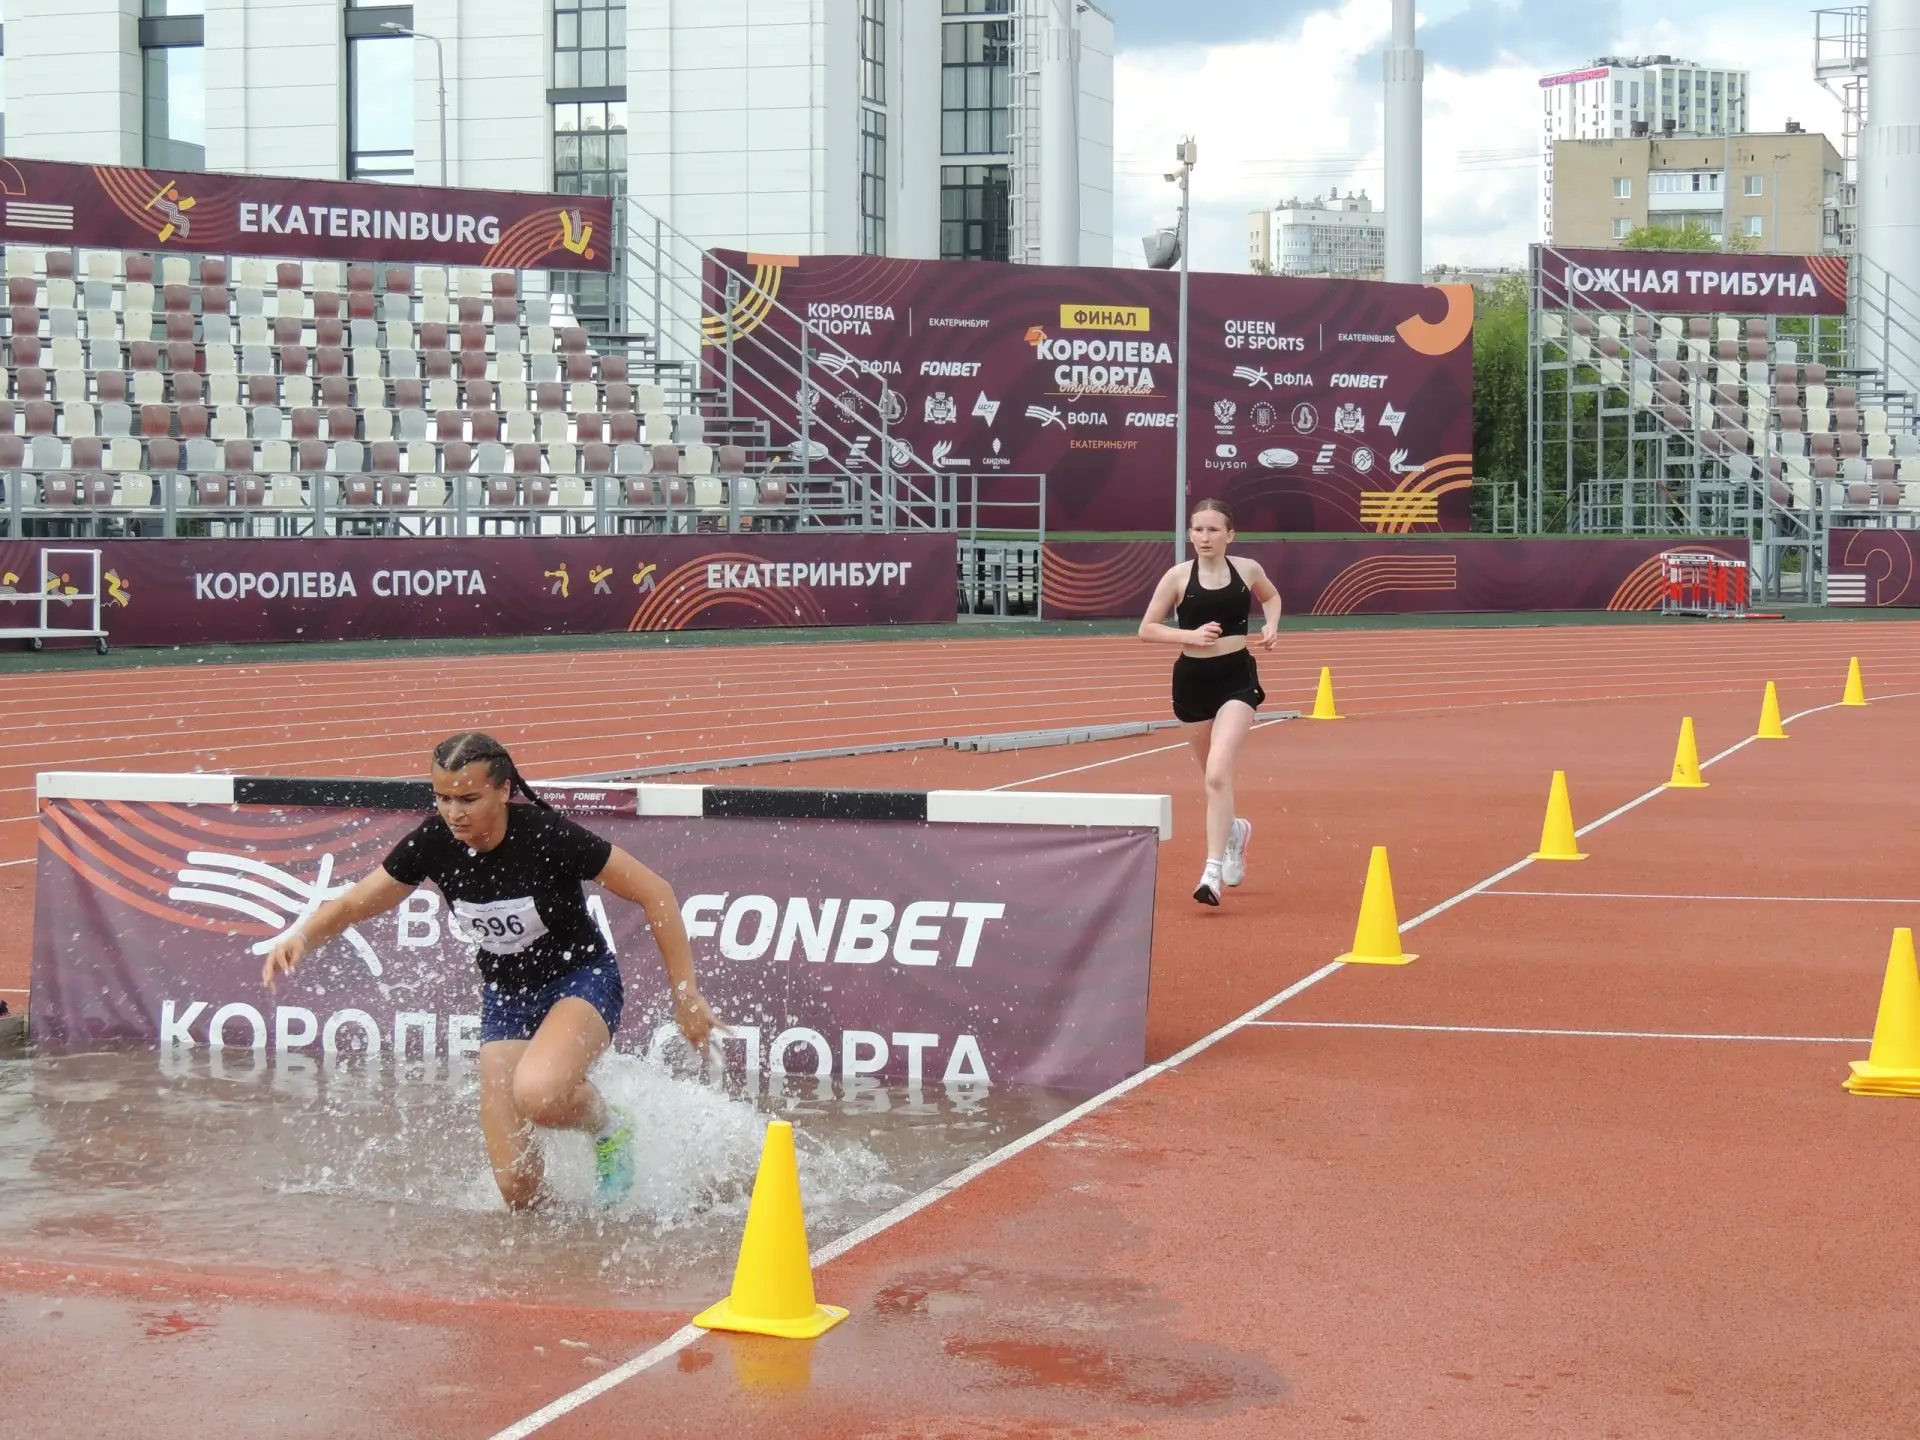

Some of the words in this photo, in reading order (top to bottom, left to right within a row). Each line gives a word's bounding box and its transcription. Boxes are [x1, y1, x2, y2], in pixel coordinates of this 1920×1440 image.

[239, 202, 500, 245] EKATERINBURG
[1564, 266, 1678, 294] ЮЖНАЯ
[1685, 270, 1817, 298] ТРИБУНА
[807, 302, 895, 321] КОРОЛЕВА
[1073, 309, 1137, 327] ФИНАЛ
[807, 319, 872, 336] СПОРТА
[928, 317, 990, 328] ЕКАТЕРИНБУРГ
[1224, 319, 1276, 335] QUEEN
[1224, 335, 1245, 349] OF
[1248, 336, 1305, 351] SPORTS
[1338, 333, 1396, 343] EKATERINBURG
[1036, 338, 1173, 364] КОРОЛЕВА
[860, 360, 902, 374] ВФЛА
[919, 361, 982, 377] FONBET
[1054, 364, 1155, 389] СПОРТА
[1273, 372, 1313, 386] ВФЛА
[1330, 373, 1388, 389] FONBET
[1067, 411, 1108, 425] ВФЛА
[1070, 439, 1138, 450] ЕКАТЕРИНБУРГ
[1205, 458, 1247, 471] buyson
[707, 561, 913, 589] ЕКАТЕРИНБУРГ
[195, 571, 358, 600] КОРОЛЕВА
[372, 569, 487, 597] СПОРТА
[543, 792, 566, 801] ВФЛА
[573, 792, 606, 801] FONBET
[681, 893, 1006, 968] FONBET
[160, 1000, 483, 1056] КОРОЛЕ
